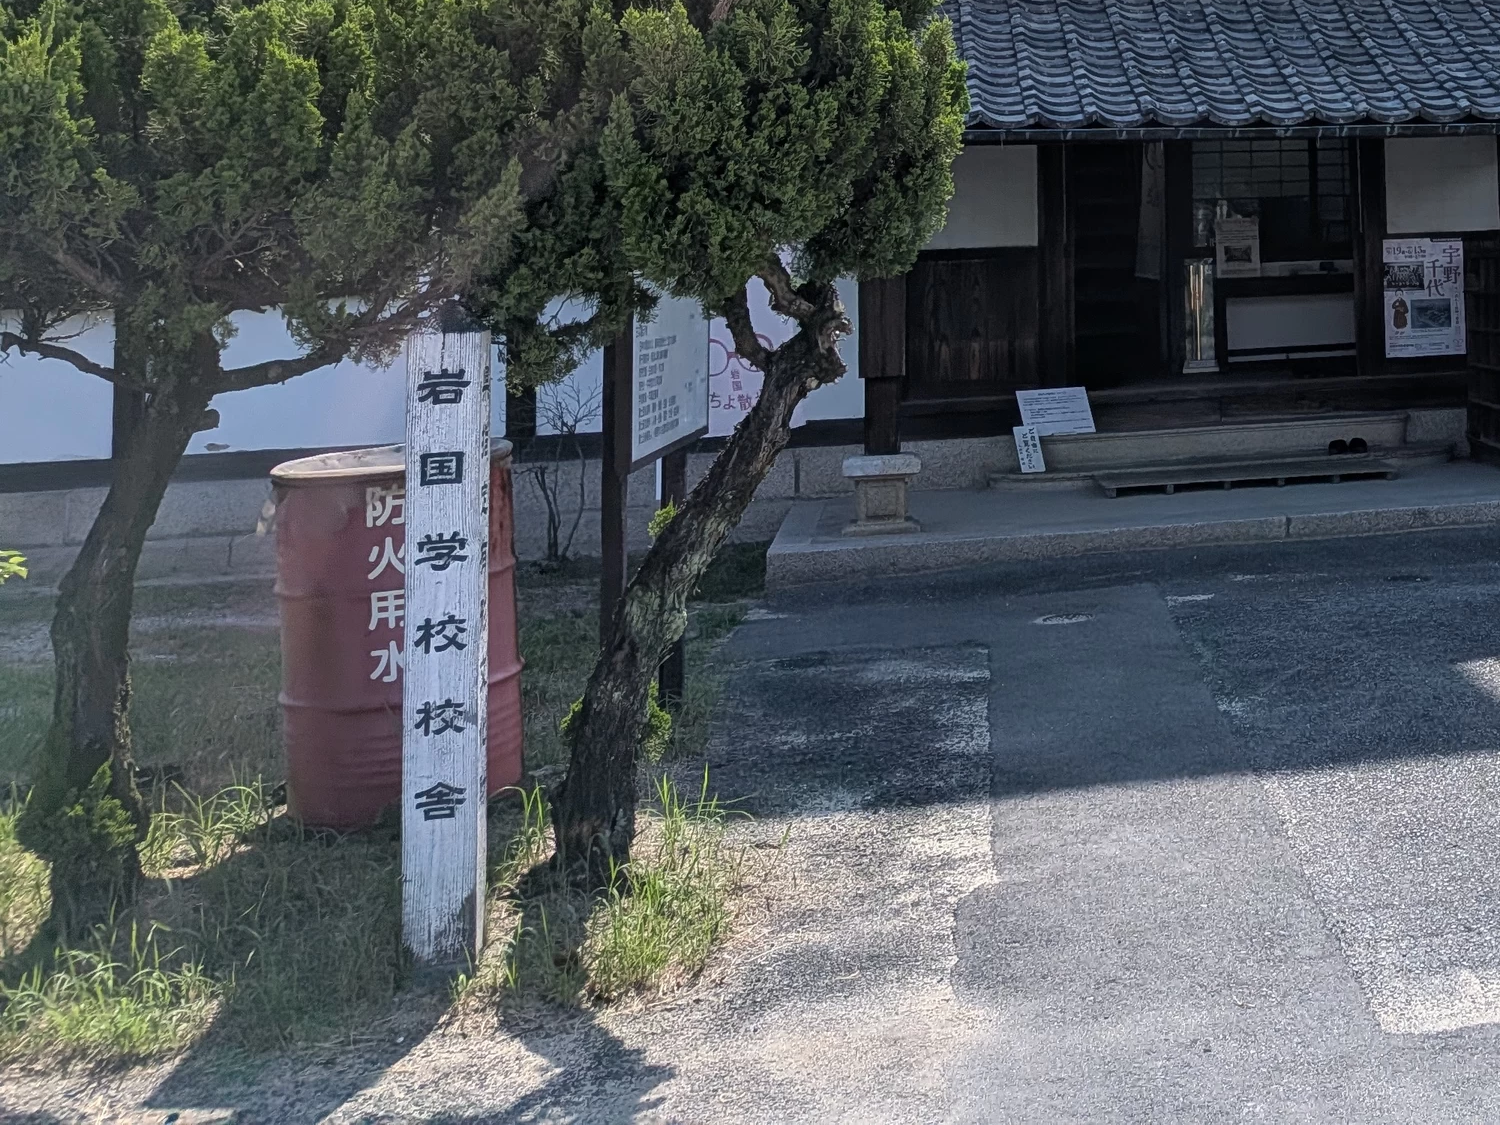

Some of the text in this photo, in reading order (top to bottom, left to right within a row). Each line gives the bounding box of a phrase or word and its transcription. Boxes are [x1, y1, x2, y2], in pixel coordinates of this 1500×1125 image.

[1426, 259, 1445, 297] 千代
[1442, 245, 1461, 284] 宇野
[731, 369, 743, 392] 岩国
[709, 391, 761, 412] ちよ散
[366, 484, 406, 683] 防火用水
[414, 368, 472, 821] 岩国学校校舎
